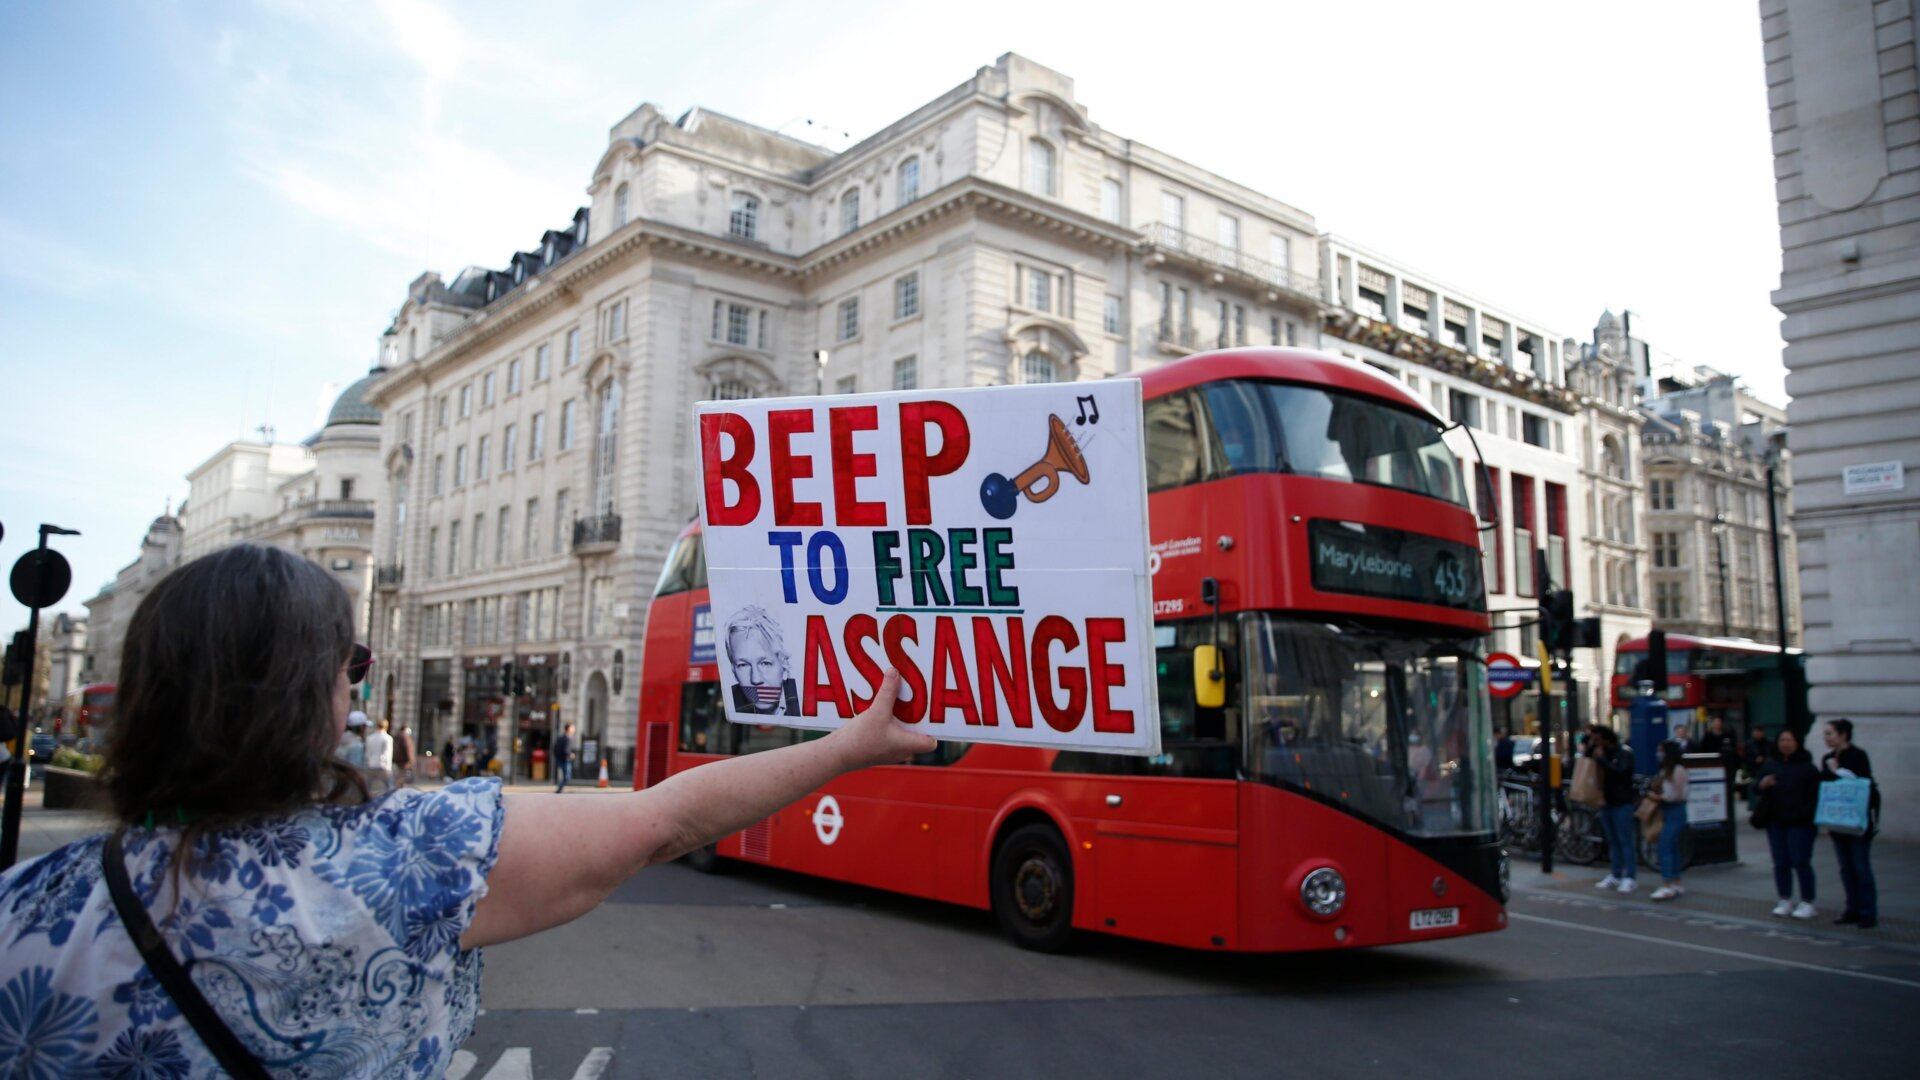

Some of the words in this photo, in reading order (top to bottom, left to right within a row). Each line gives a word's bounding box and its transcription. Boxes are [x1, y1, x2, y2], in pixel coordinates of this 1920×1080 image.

[700, 401, 970, 526] BEEP
[768, 530, 849, 604] TO
[872, 527, 1020, 607] FREE
[1319, 543, 1413, 578] Marylebone
[1434, 560, 1465, 597] 453
[803, 613, 1135, 734] ASSANGE
